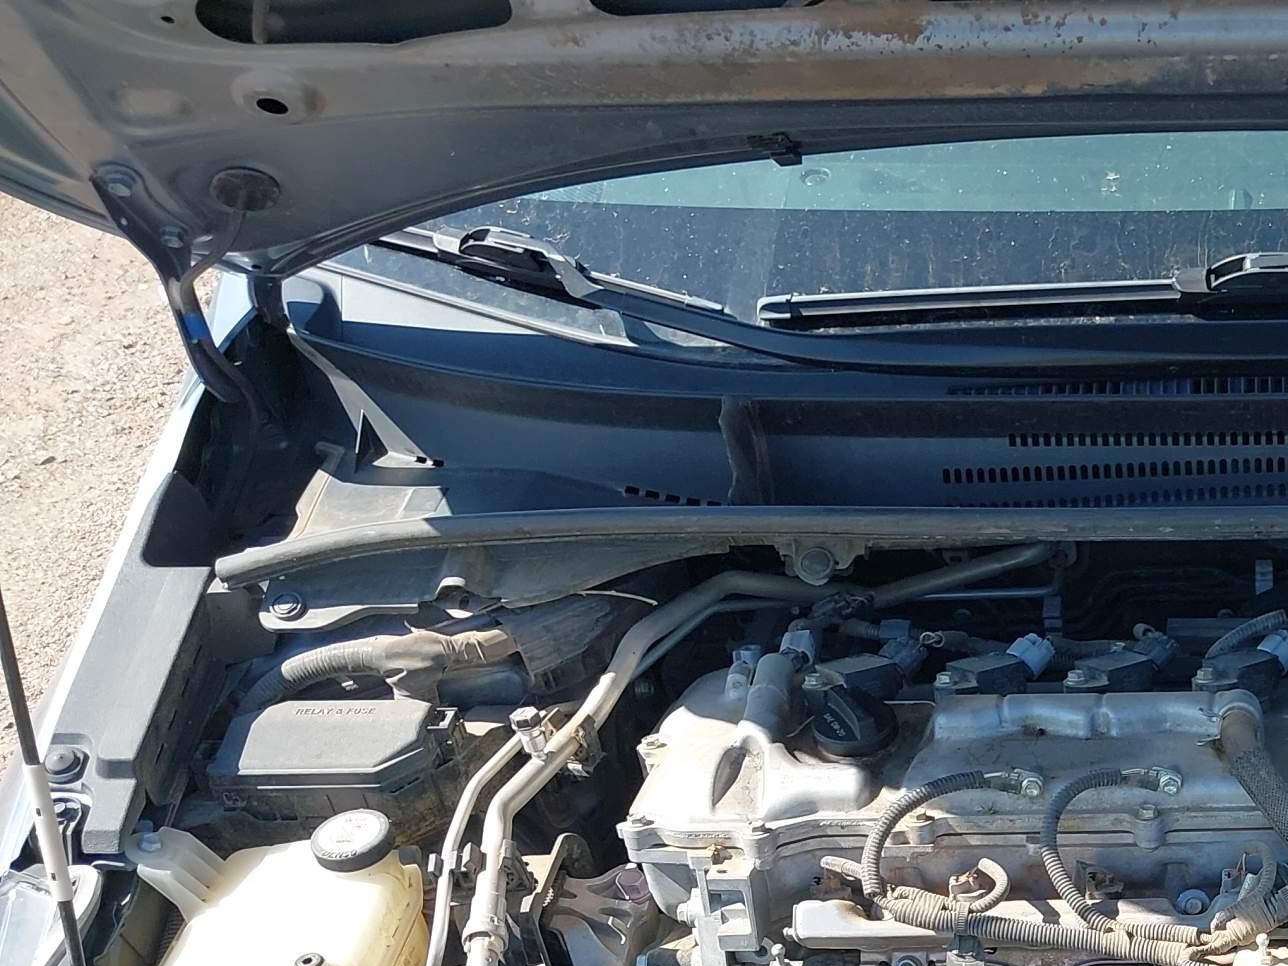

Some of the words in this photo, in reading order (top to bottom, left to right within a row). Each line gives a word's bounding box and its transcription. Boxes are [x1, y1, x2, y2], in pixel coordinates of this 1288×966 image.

[294, 707, 334, 716] RELAY
[335, 708, 344, 716] &
[346, 707, 377, 716] FUSE
